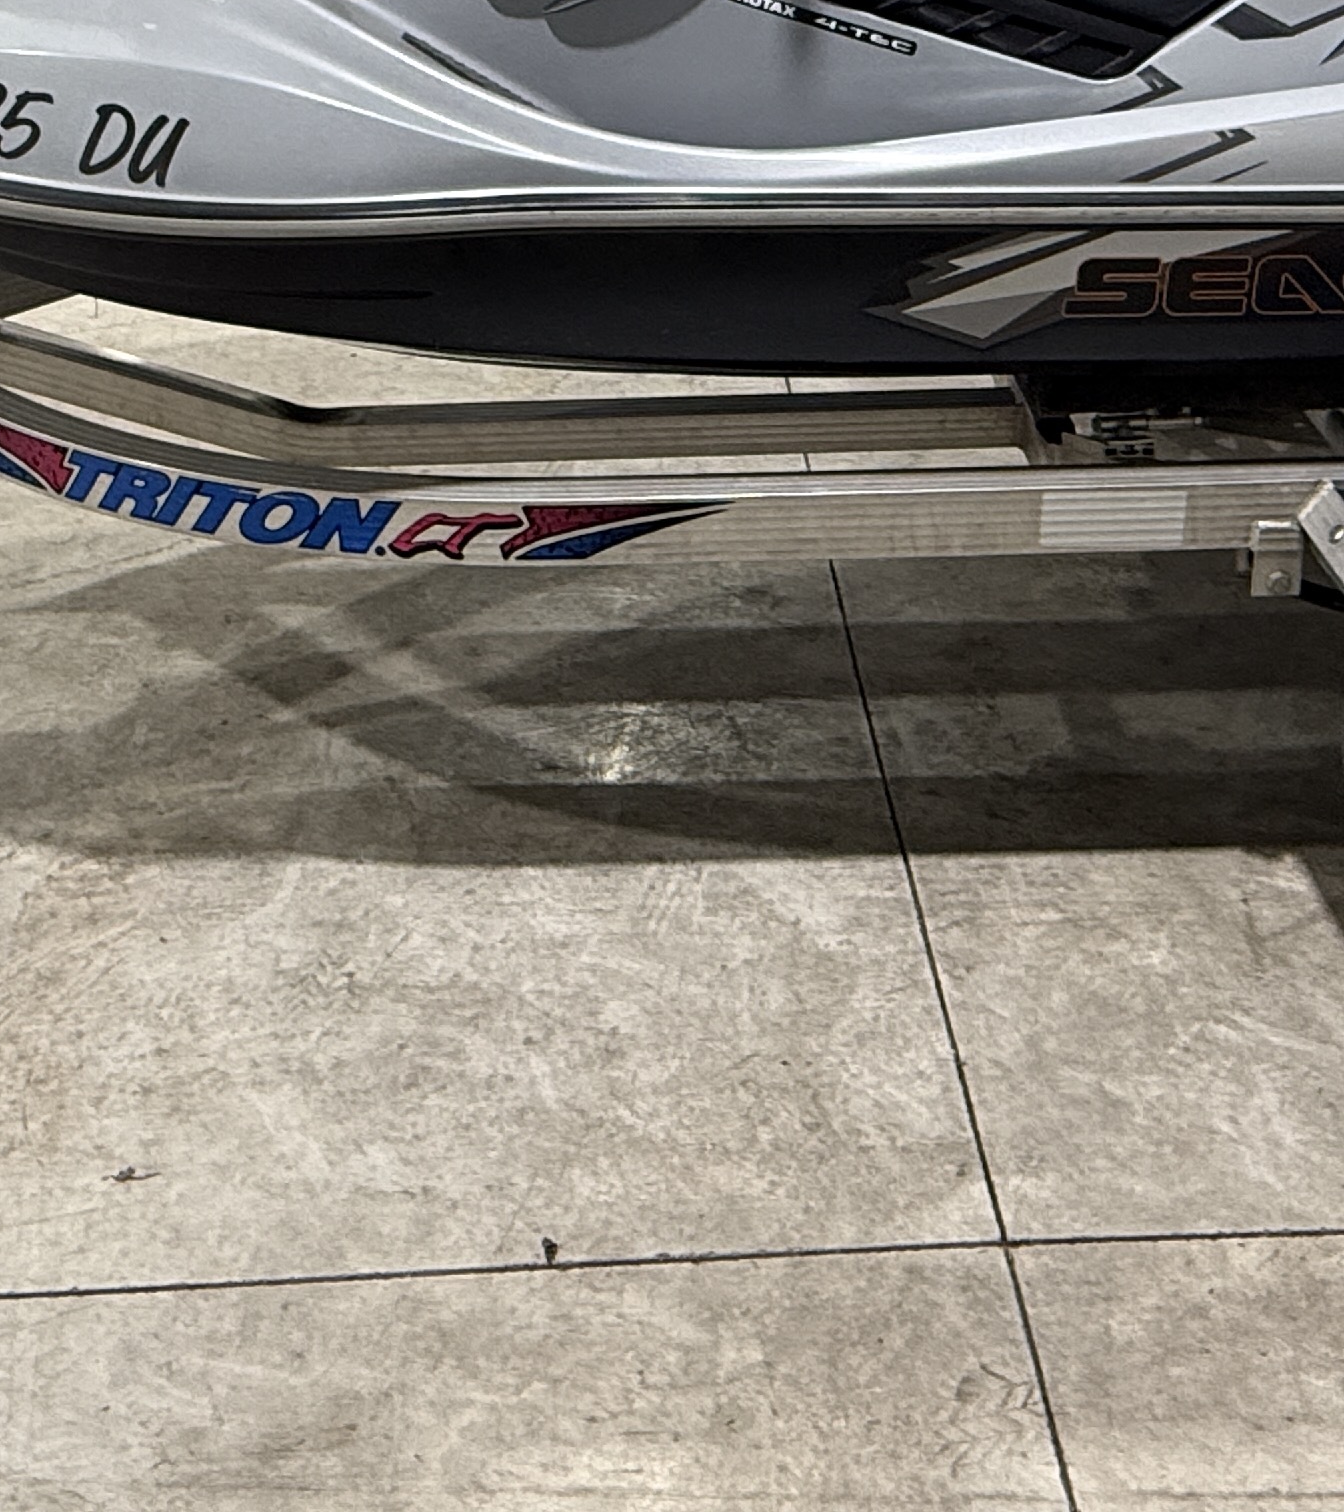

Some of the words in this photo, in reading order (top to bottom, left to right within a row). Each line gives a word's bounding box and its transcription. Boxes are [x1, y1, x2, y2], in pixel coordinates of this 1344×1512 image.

[814, 17, 913, 53] 4-TEC
[78, 103, 190, 188] DU
[65, 448, 403, 557] TRITON
